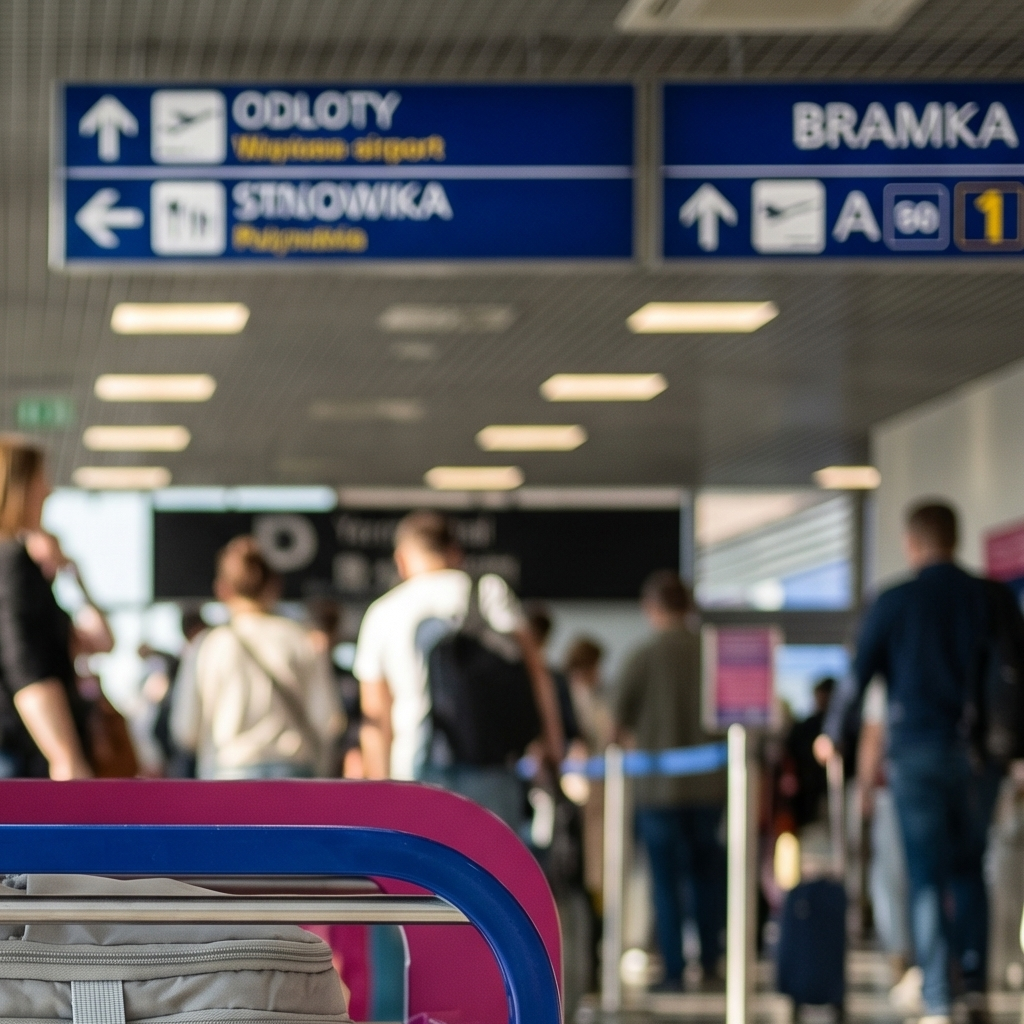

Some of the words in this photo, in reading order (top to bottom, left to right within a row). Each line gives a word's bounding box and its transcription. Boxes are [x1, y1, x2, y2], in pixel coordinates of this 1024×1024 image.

[232, 90, 401, 131] ODLOTY
[792, 101, 1019, 150] BRAMKA
[831, 190, 882, 243] A
[973, 188, 1004, 245] 1
